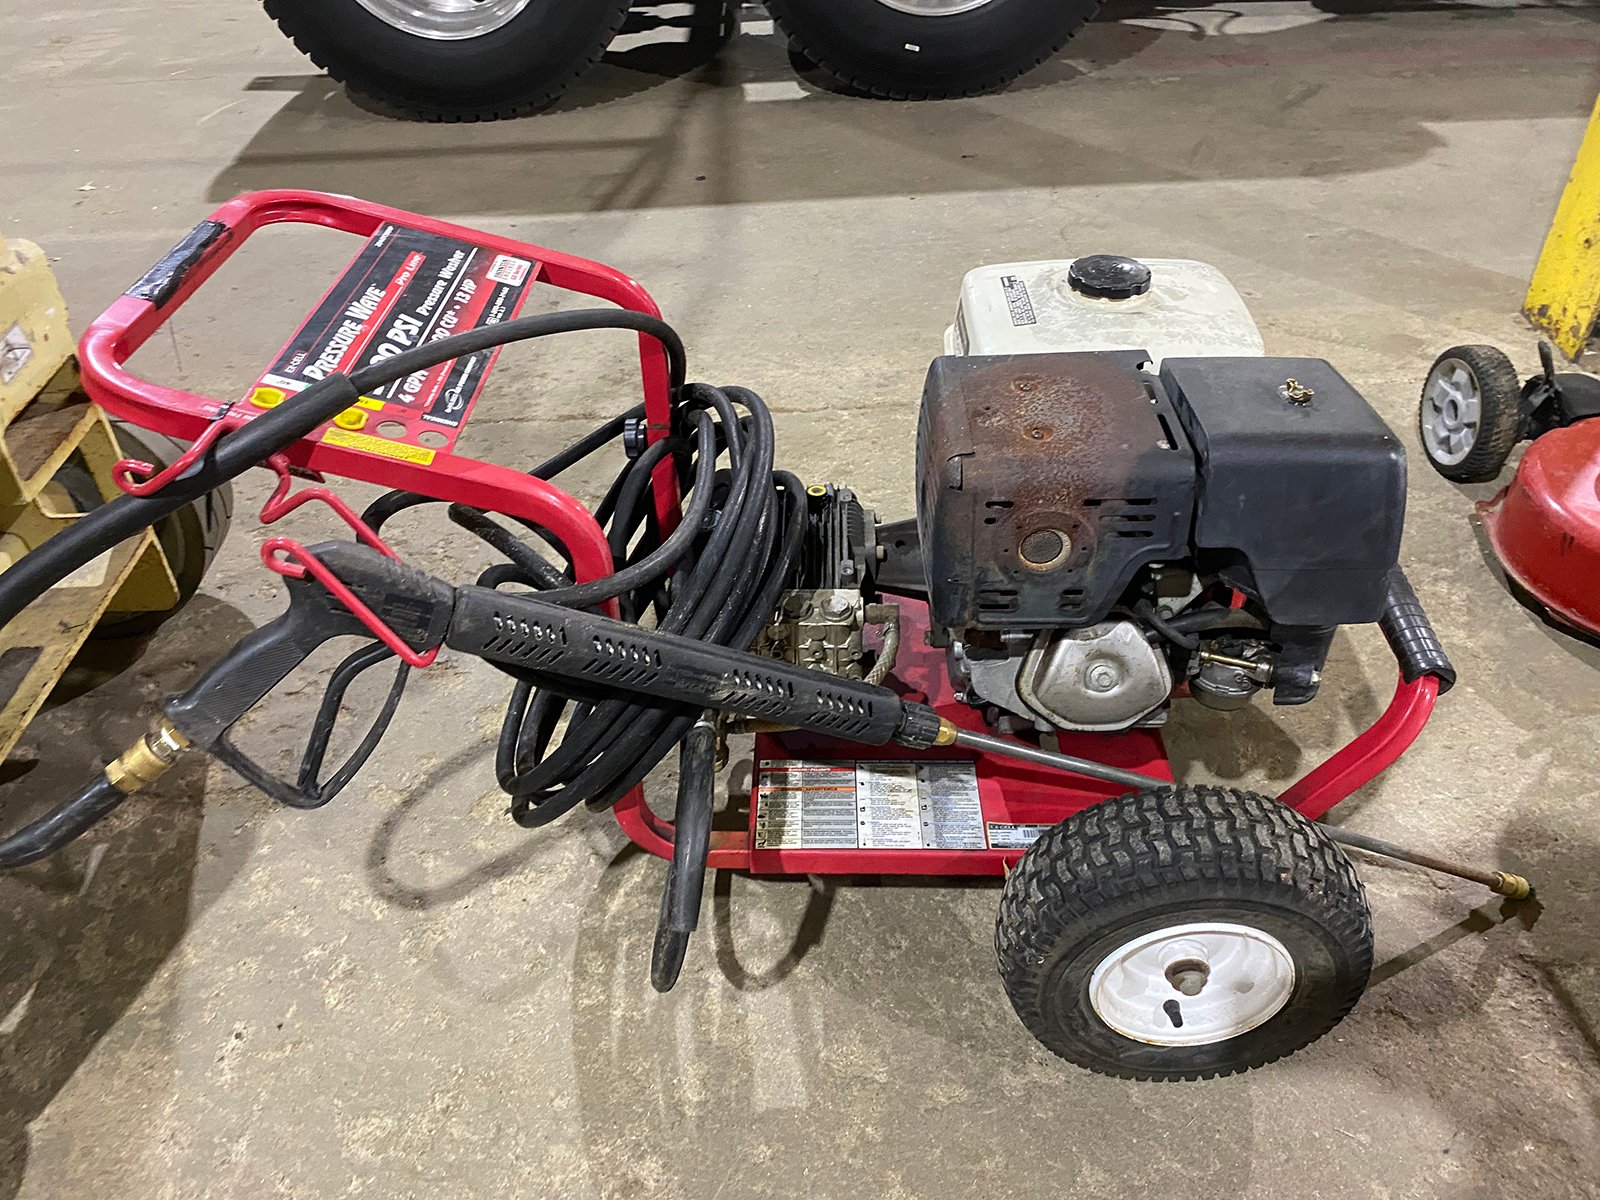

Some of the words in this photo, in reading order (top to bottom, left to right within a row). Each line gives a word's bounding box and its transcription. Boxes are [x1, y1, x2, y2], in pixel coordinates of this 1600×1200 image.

[396, 272, 411, 286] Pro
[405, 255, 422, 271] Line
[386, 314, 423, 346] PSI
[416, 280, 447, 316] Pressure
[438, 250, 465, 279] Washer
[454, 292, 471, 304] 13
[460, 279, 477, 294] HP
[302, 320, 363, 380] PRESSURE
[345, 287, 386, 320] WAVE
[405, 370, 428, 393] GPM
[398, 394, 415, 403] 4
